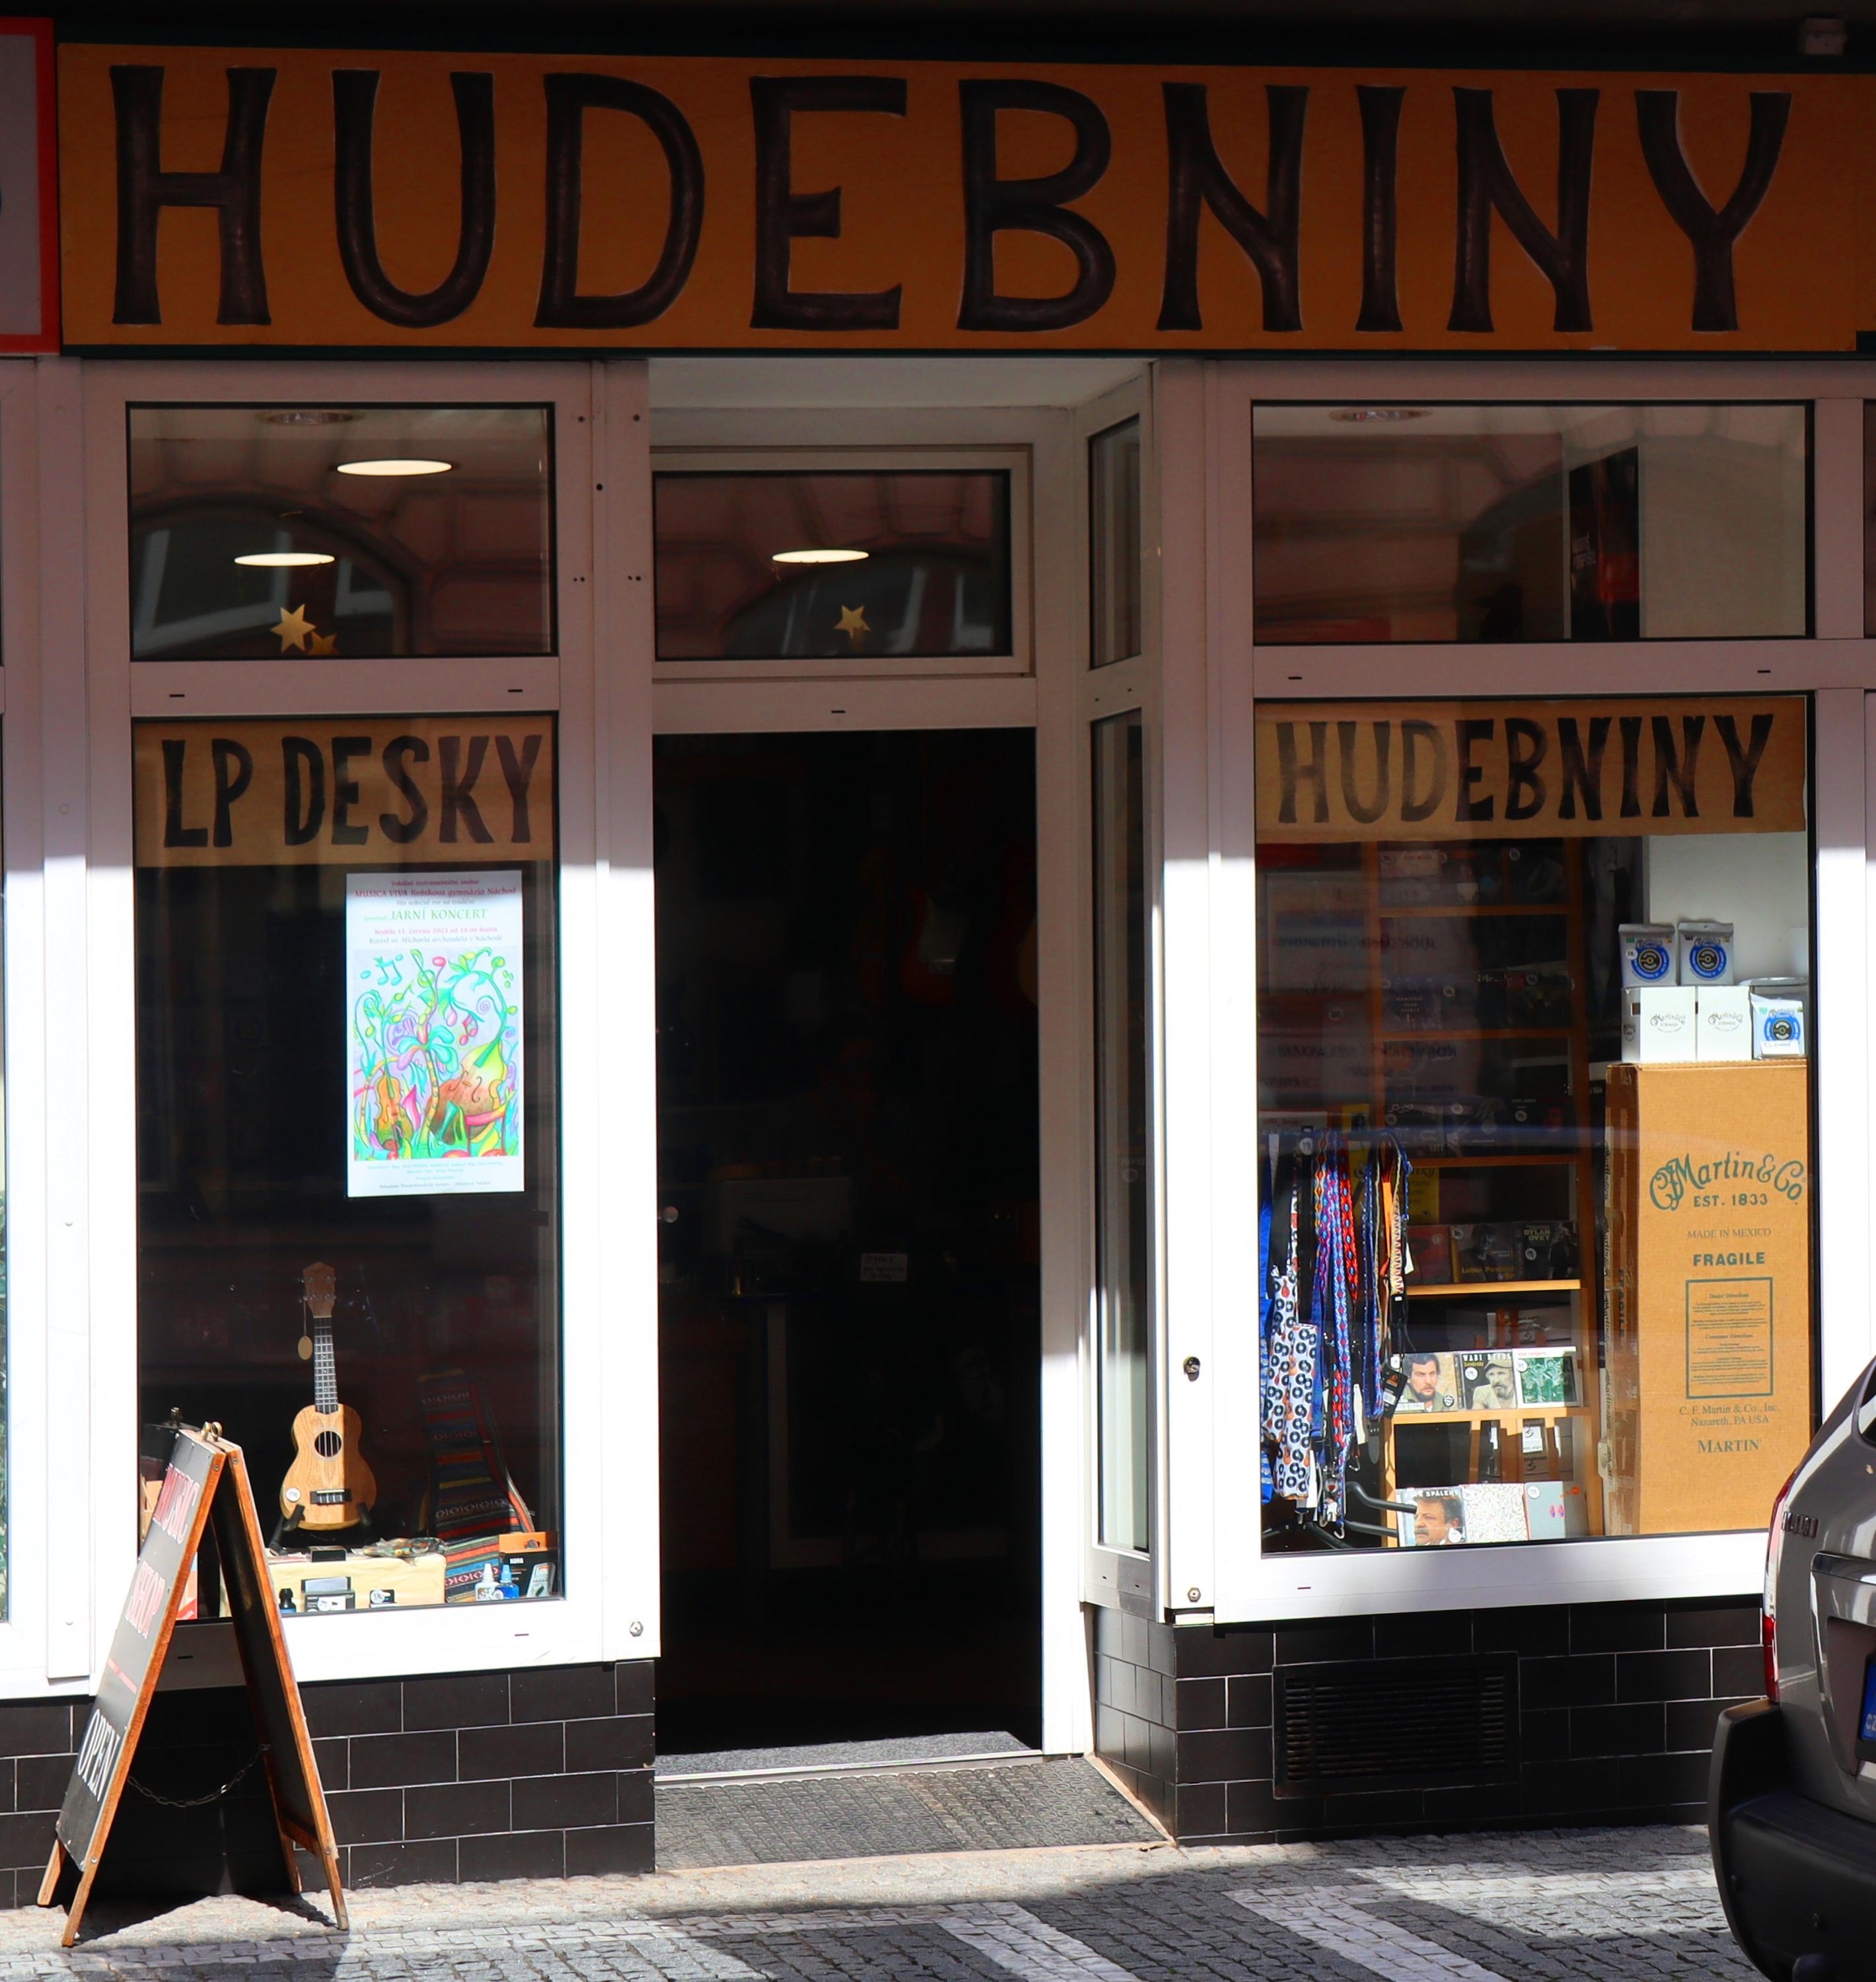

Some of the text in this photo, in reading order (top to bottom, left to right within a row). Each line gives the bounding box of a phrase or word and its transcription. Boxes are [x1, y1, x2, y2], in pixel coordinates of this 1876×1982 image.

[110, 65, 1791, 332] HUDEBNINY
[1276, 714, 1774, 823] HUDEBNINY
[161, 735, 542, 848] LP DESKY
[389, 907, 426, 921] JARNÍ
[431, 908, 488, 920] KONCERT
[1694, 1193, 1768, 1208] EST. 1833
[1687, 1230, 1717, 1239] MADE
[1732, 1228, 1772, 1237] MEXICO
[1692, 1251, 1766, 1266] FRAGILE
[1680, 1406, 1690, 1415] C.
[1702, 1405, 1731, 1414] Martin
[1764, 1403, 1780, 1412] Inc.
[1691, 1415, 1770, 1427] Nazareth, PA USA
[1697, 1439, 1760, 1453] MARTIN
[152, 1462, 200, 1545] MUSIC
[126, 1560, 166, 1639] SHOP
[77, 1708, 121, 1802] OPEN
